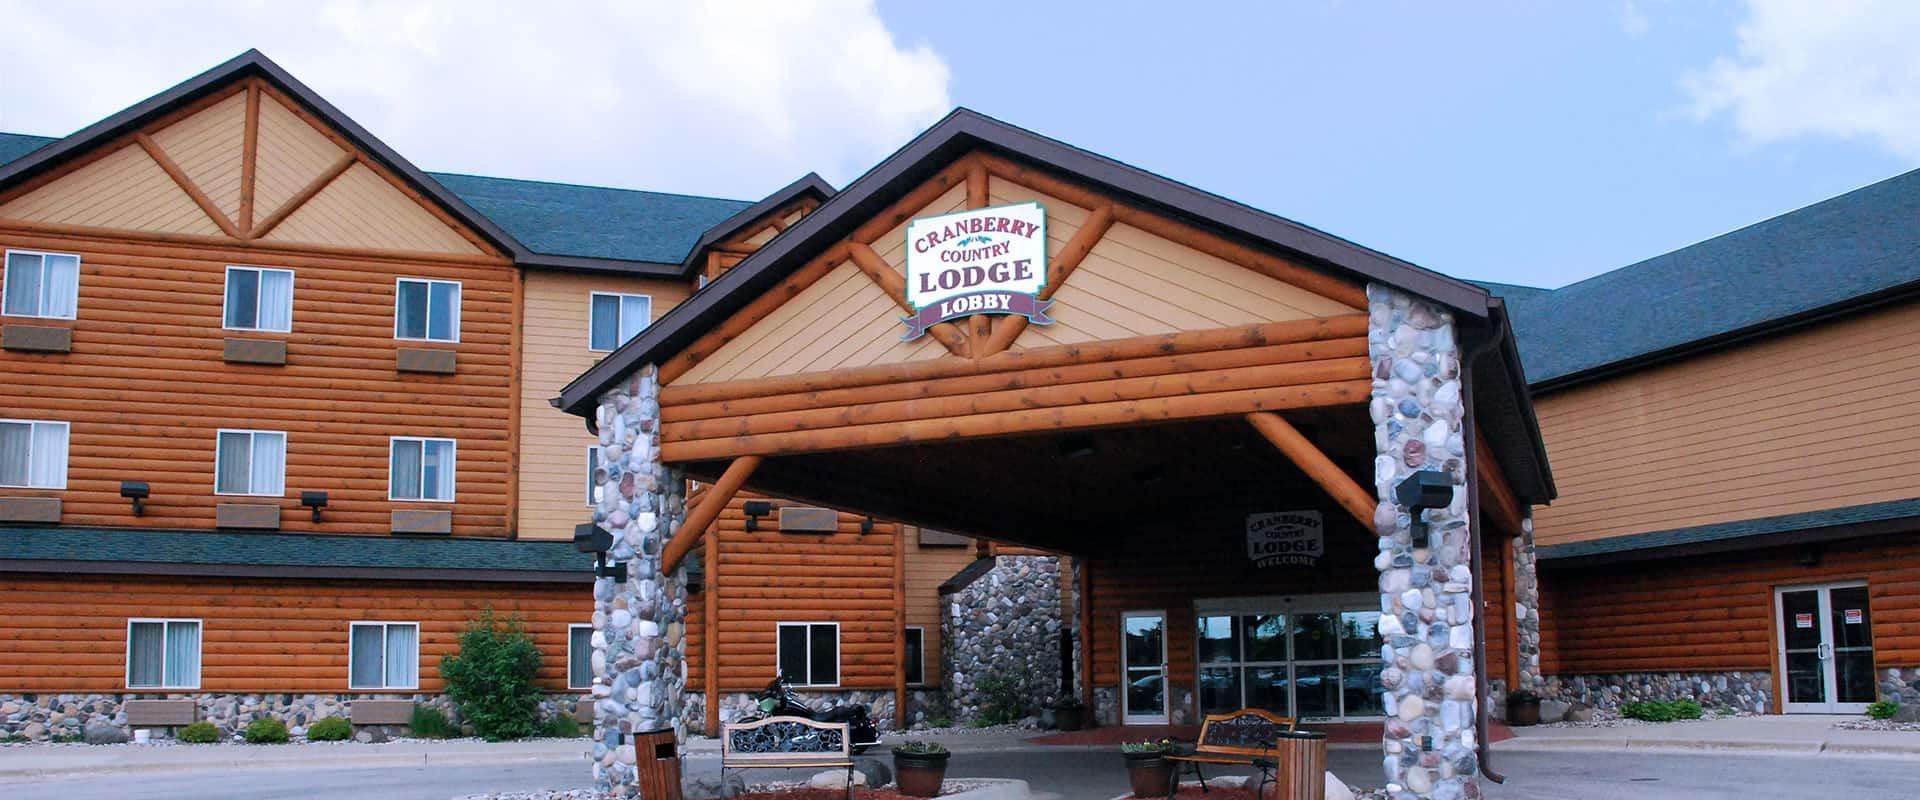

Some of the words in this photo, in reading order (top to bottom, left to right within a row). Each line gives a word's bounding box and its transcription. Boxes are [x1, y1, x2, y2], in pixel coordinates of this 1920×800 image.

[915, 216, 1040, 253] CRANBERRY
[940, 240, 1010, 263] COUNTRY
[919, 258, 1033, 293] LODGE
[940, 294, 1012, 318] LOBBY
[1253, 539, 1320, 554] LODGE
[1257, 555, 1316, 568] WELCOME
